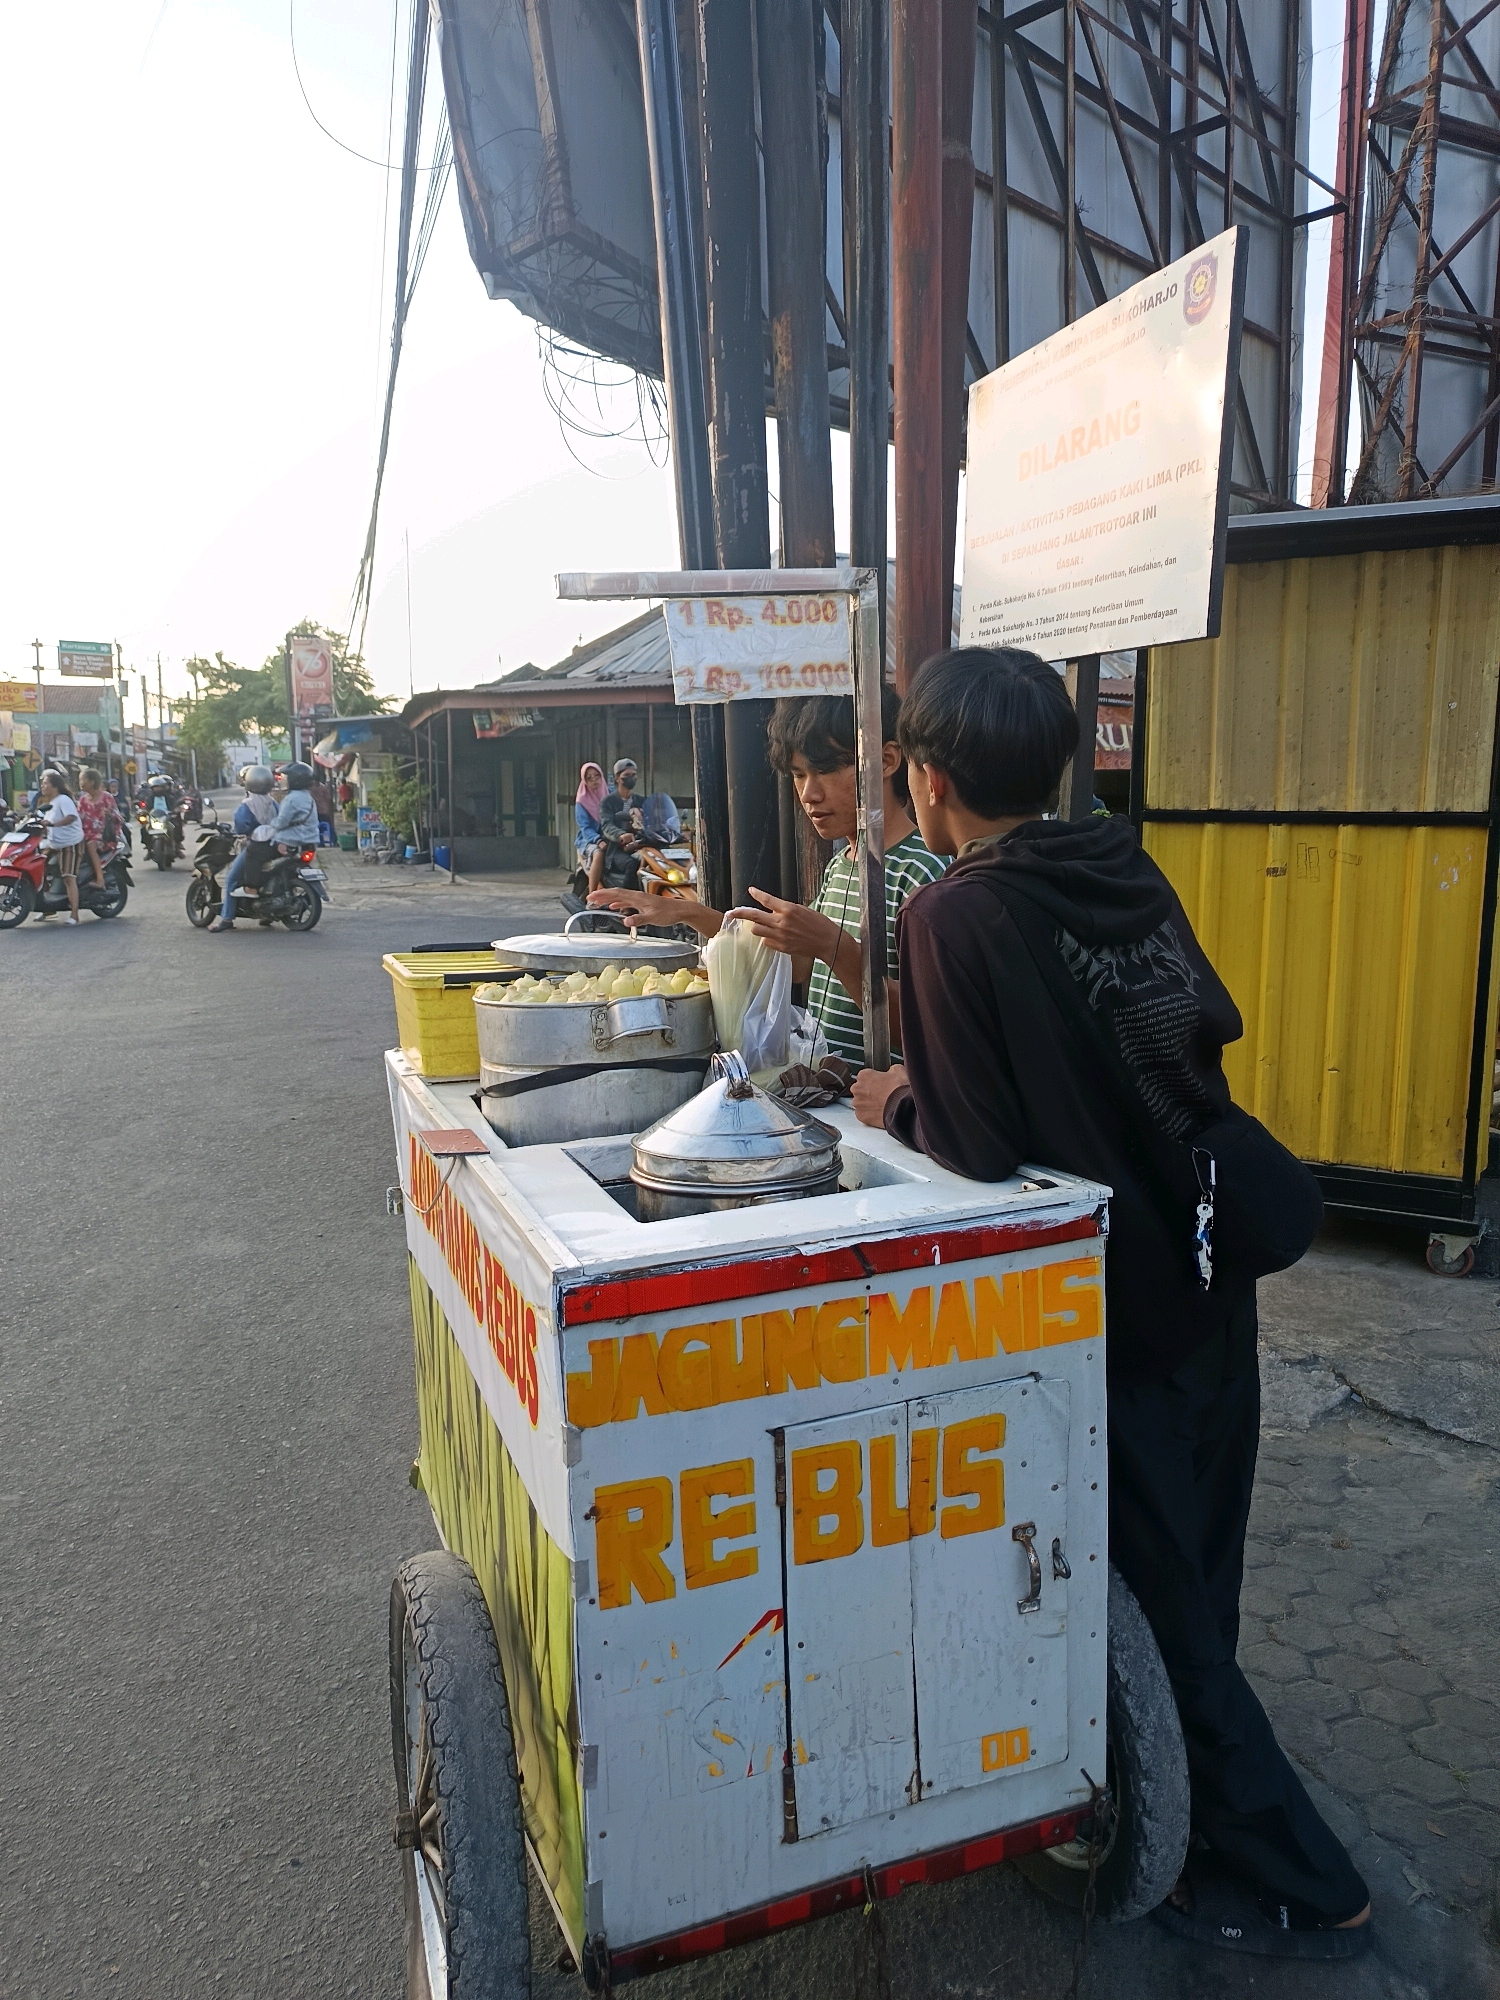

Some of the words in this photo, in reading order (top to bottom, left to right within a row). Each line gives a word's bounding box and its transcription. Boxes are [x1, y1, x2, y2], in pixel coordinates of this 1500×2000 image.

[999, 357, 1050, 394] PEMERINTAH
[1052, 322, 1108, 366] KABUPATEN
[1111, 282, 1178, 331] SUKOHARJO
[1054, 356, 1097, 386] KABUPATEN
[1098, 326, 1146, 361] SUKOHARJO
[1018, 399, 1141, 483] DILARANG
[970, 525, 1015, 550] BERJUALAN
[1020, 509, 1064, 534] AKTIVITAS
[1066, 489, 1117, 518] PEDAGANG
[1119, 479, 1144, 500] KAKI
[1146, 469, 1173, 490] LIMA
[1175, 456, 1207, 483] (PKL)
[1001, 549, 1010, 564] DI
[1012, 535, 1060, 561] SEPANJANG
[1142, 504, 1157, 522] INI
[1056, 555, 1080, 571] DASAR
[1164, 556, 1177, 566] dan
[679, 600, 694, 626] 1
[705, 600, 753, 633] Rp.
[760, 598, 839, 627] 4.000
[1039, 616, 1055, 625] Tahun
[1070, 608, 1091, 620] tentang
[1092, 601, 1123, 615] Ketertiban
[1124, 598, 1144, 608] Umum
[1067, 623, 1088, 635] tentang
[1117, 616, 1129, 625] dan
[1130, 608, 1178, 623] Pemberdayaan
[705, 664, 750, 697] Rp.
[758, 660, 850, 689] 10.000
[508, 714, 534, 727] PANAS
[1095, 722, 1133, 752] RU
[1119, 1006, 1137, 1014] takes
[1124, 1011, 1148, 1020] familiar
[1119, 1020, 1147, 1030] embrace
[1128, 1026, 1154, 1035] security
[1151, 1031, 1168, 1040] There
[482, 1239, 540, 1432] REBUS
